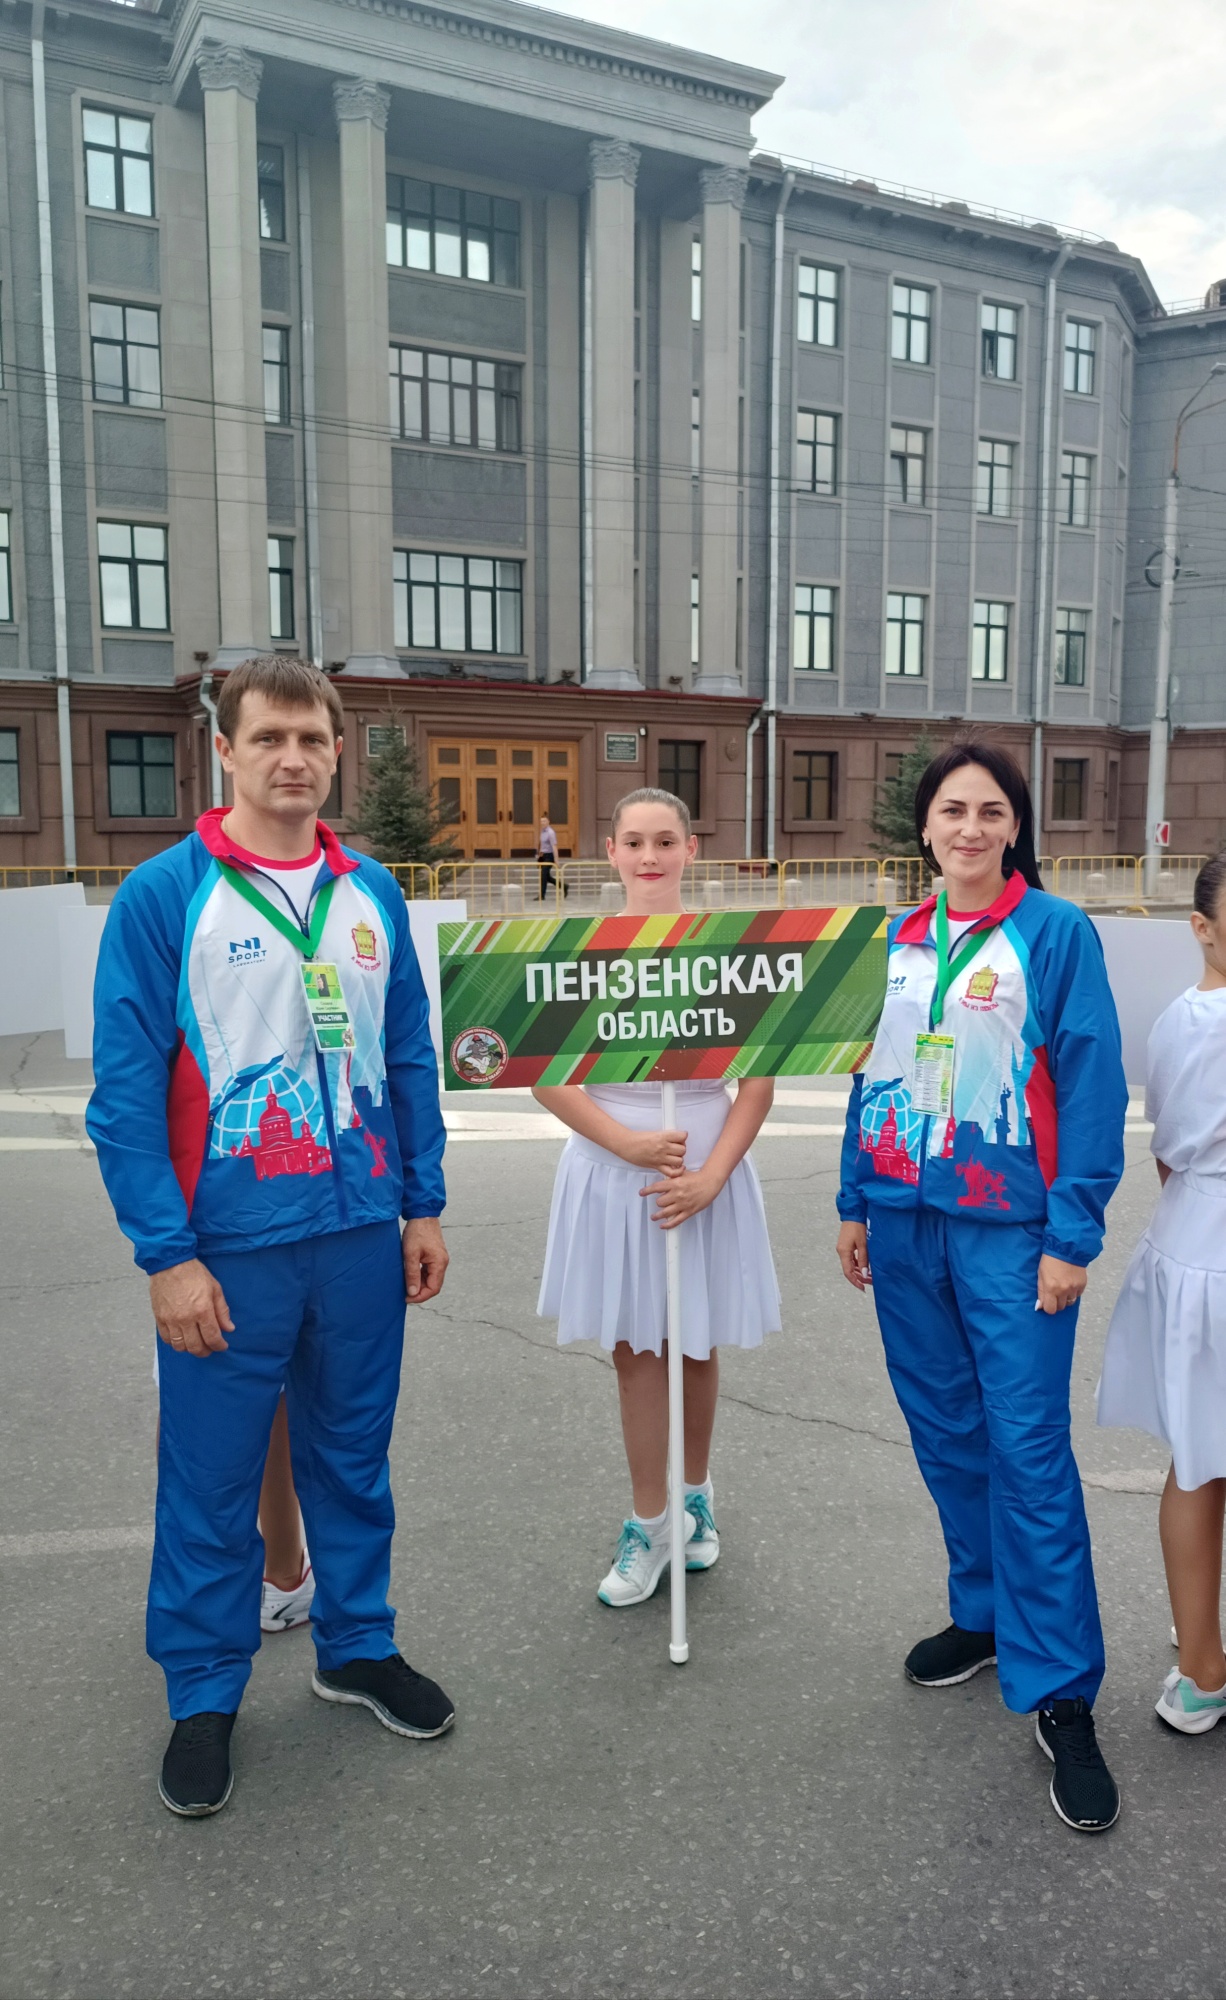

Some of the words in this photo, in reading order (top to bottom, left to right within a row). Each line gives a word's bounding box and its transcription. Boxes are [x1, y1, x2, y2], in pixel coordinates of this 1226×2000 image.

[228, 950, 267, 963] SPORT
[525, 953, 804, 1003] ПЕНЗЕНСКАЯ
[597, 1008, 736, 1041] ОБЛАСТЬ
